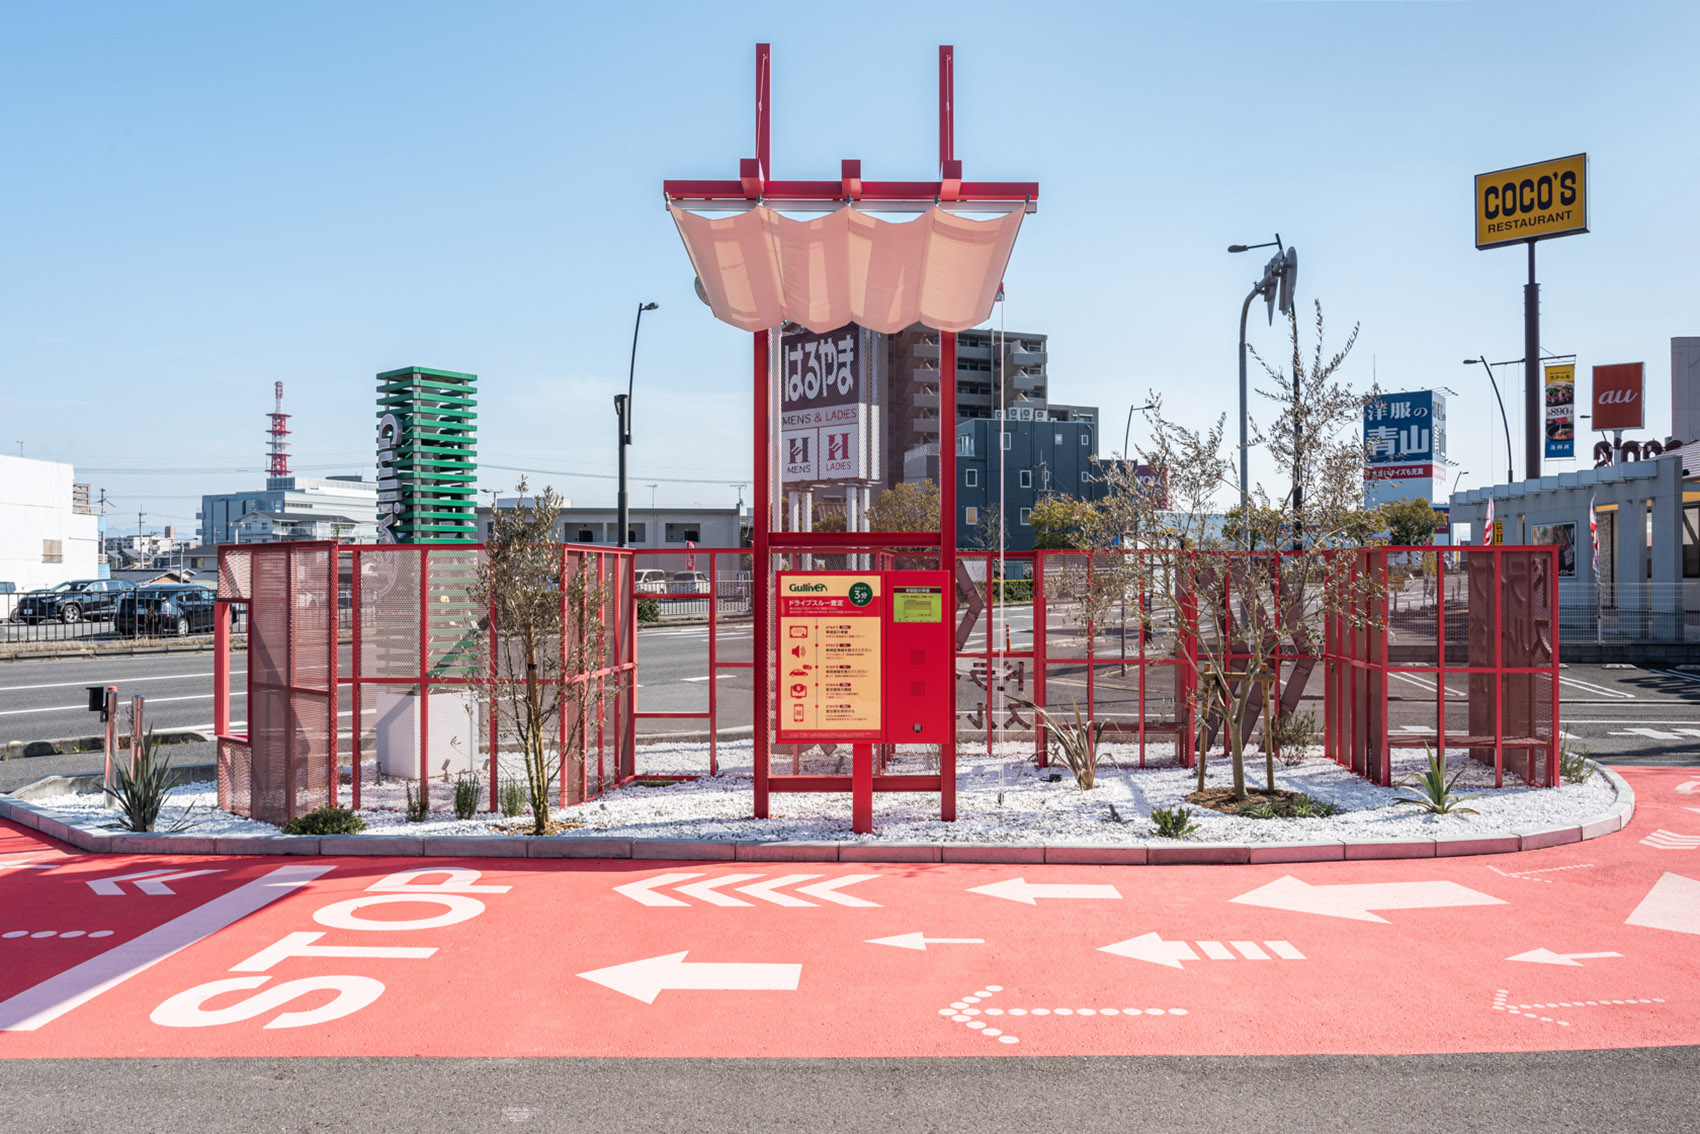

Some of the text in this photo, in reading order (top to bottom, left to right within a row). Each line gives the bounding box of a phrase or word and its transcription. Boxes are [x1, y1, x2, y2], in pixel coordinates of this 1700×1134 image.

[1484, 170, 1577, 220] COCO'S
[1488, 210, 1573, 234] RESTAURANT
[785, 334, 854, 402] はるやま
[1598, 388, 1638, 405] au
[782, 408, 857, 426] MENS & LADIES
[1368, 401, 1428, 421] 洋服の
[1368, 425, 1430, 455] 青山
[787, 464, 811, 474] MENS
[826, 461, 851, 471] LADIES
[789, 583, 828, 592] Gulliver
[150, 867, 513, 1030] STOP
